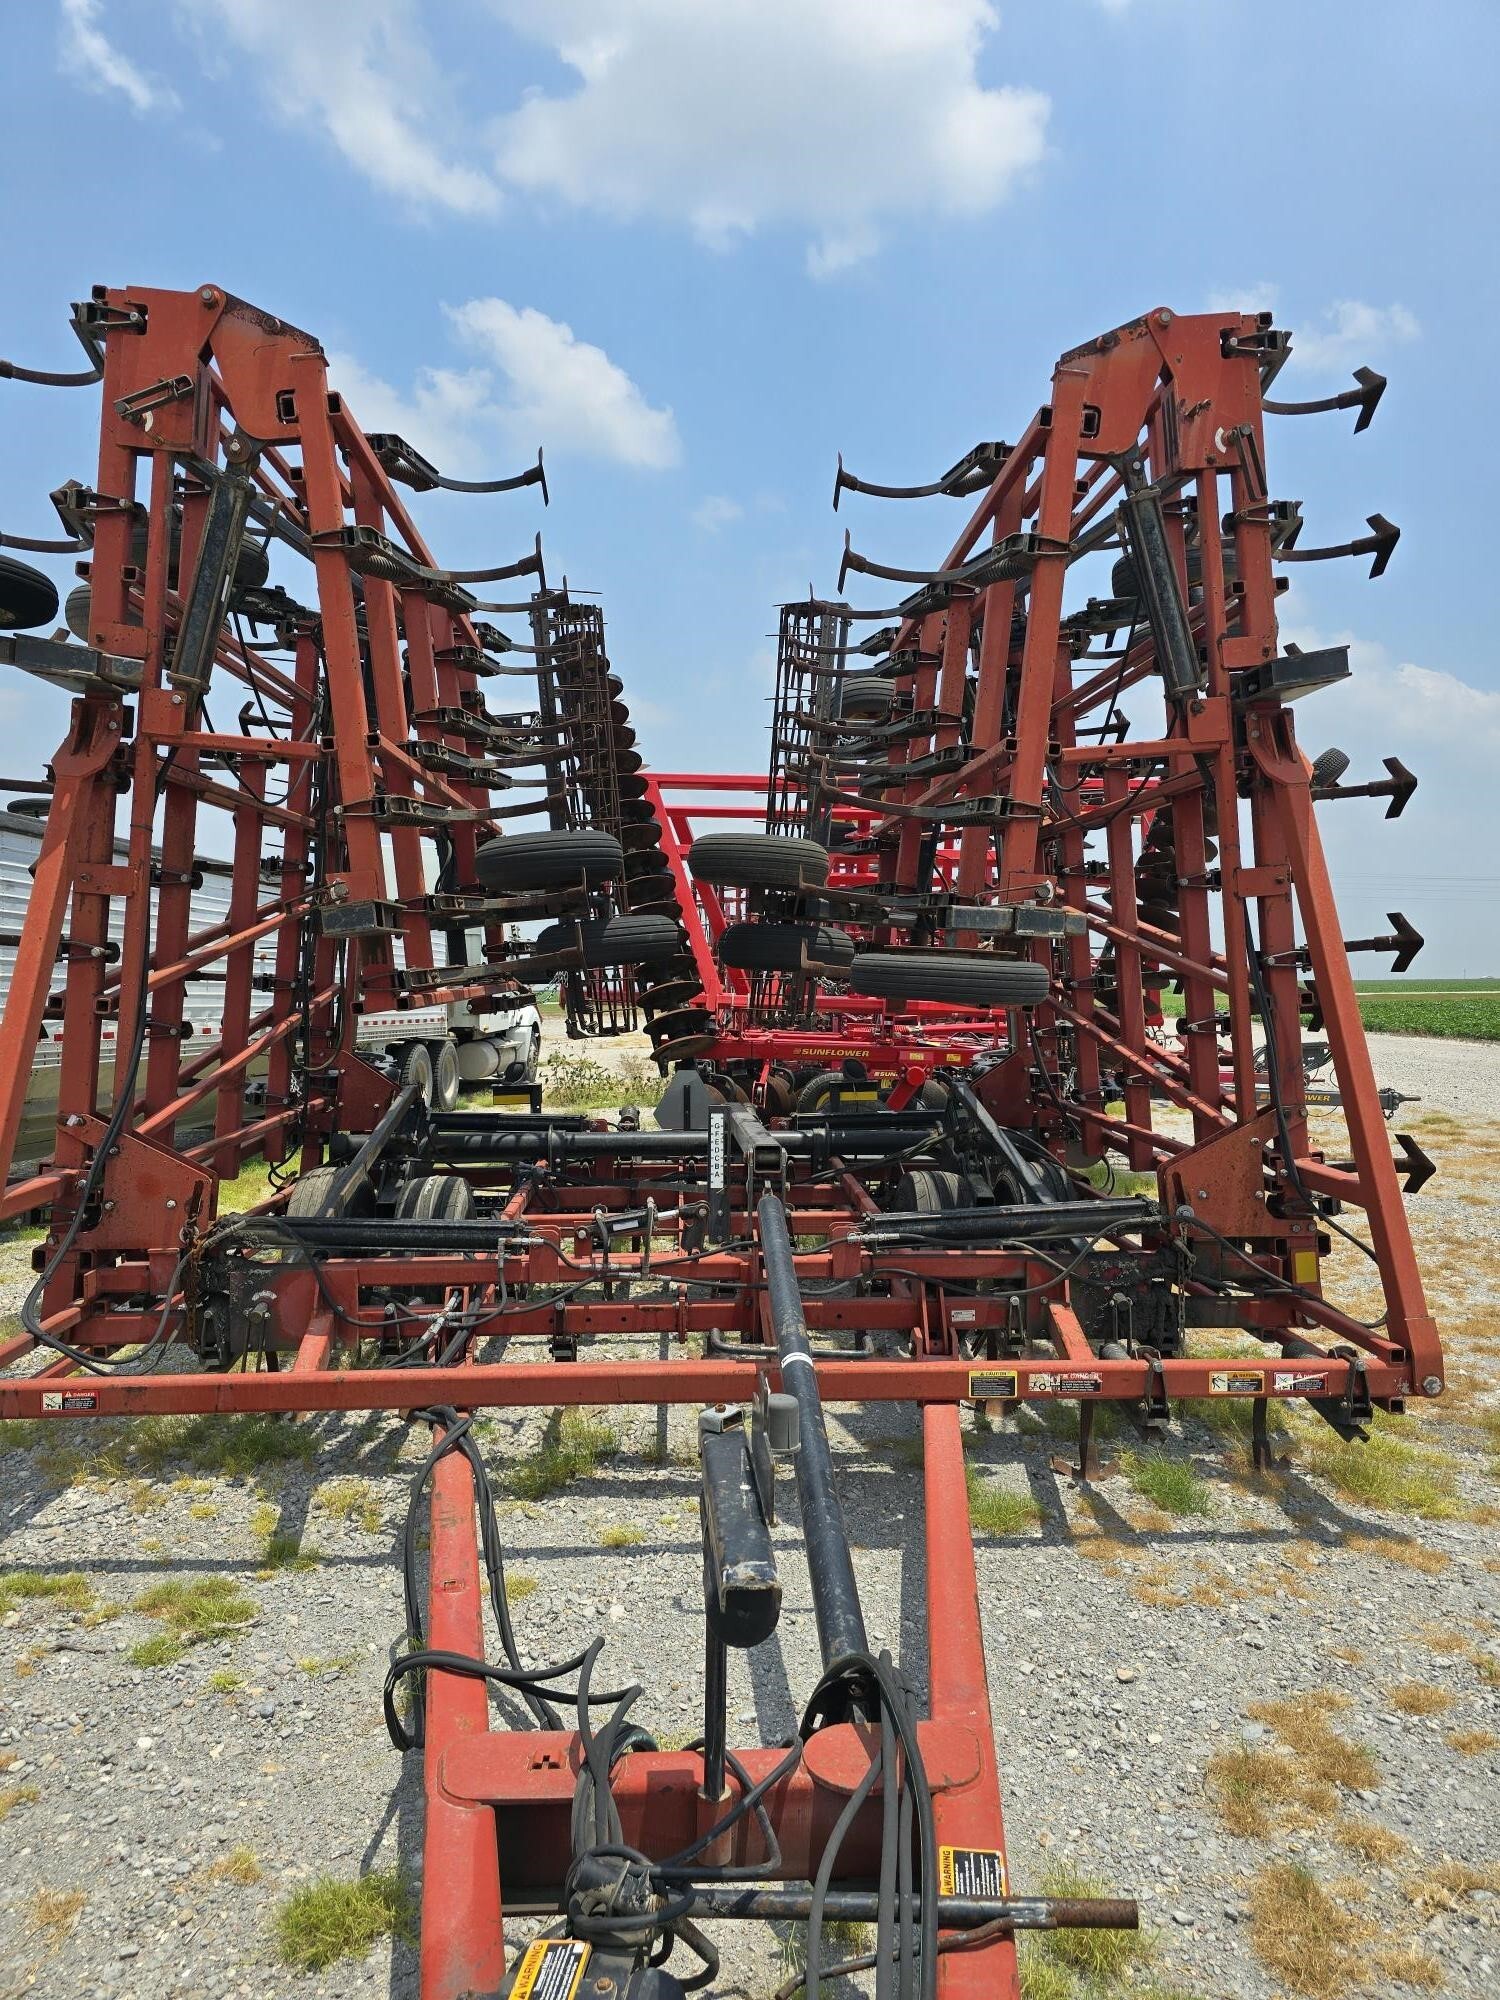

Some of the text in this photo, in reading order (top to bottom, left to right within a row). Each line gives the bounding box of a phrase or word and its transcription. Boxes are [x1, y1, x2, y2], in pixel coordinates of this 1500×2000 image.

[801, 1048, 870, 1057] SUNFLOWER
[943, 1850, 953, 1887] WARNING
[519, 1944, 543, 1988] WARNING
